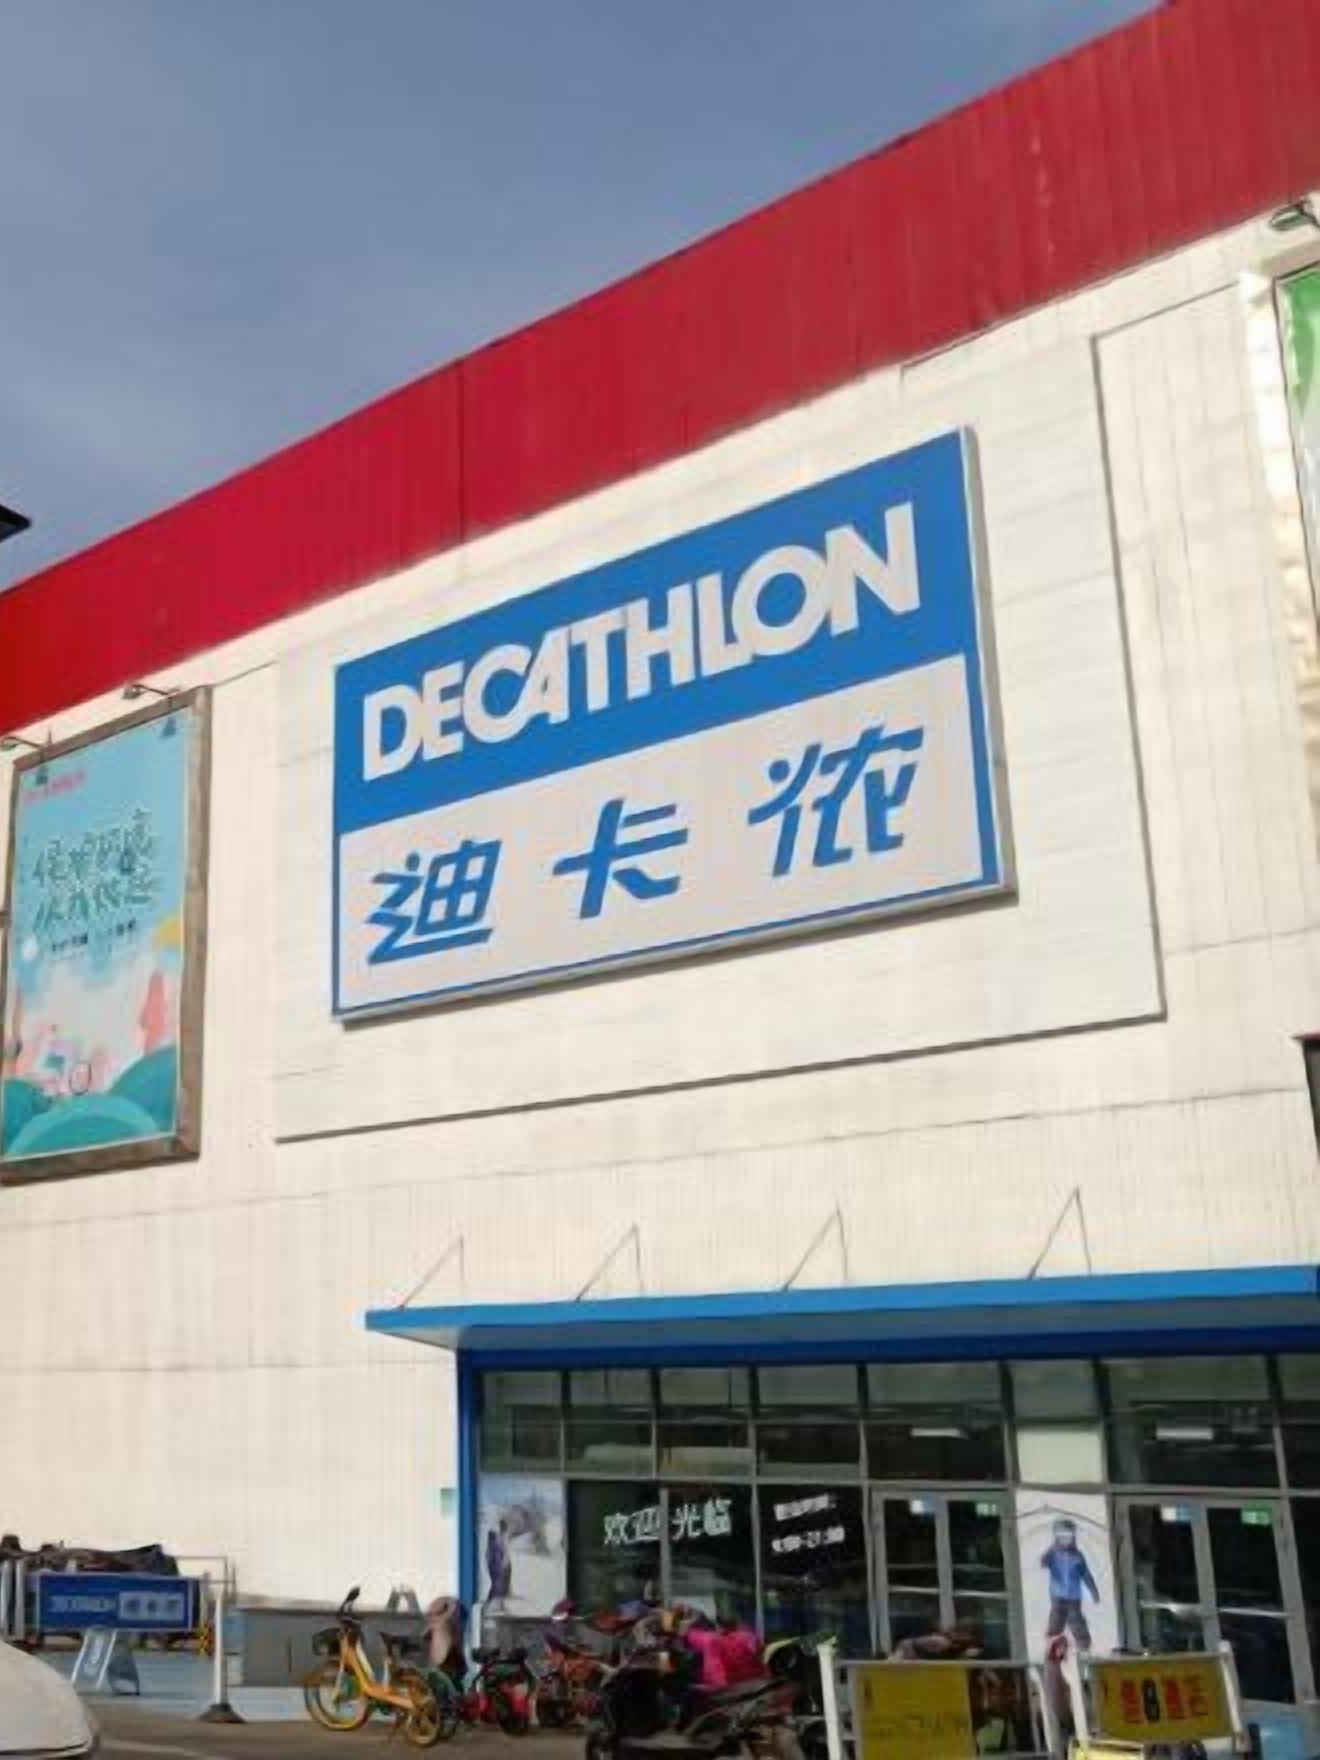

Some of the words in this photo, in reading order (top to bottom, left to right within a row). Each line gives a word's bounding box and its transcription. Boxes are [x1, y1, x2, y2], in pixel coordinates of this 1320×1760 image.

[362, 502, 921, 780] DECATHLON
[367, 722, 923, 965] 迪卡侬
[604, 1498, 732, 1544] 欢迎光临
